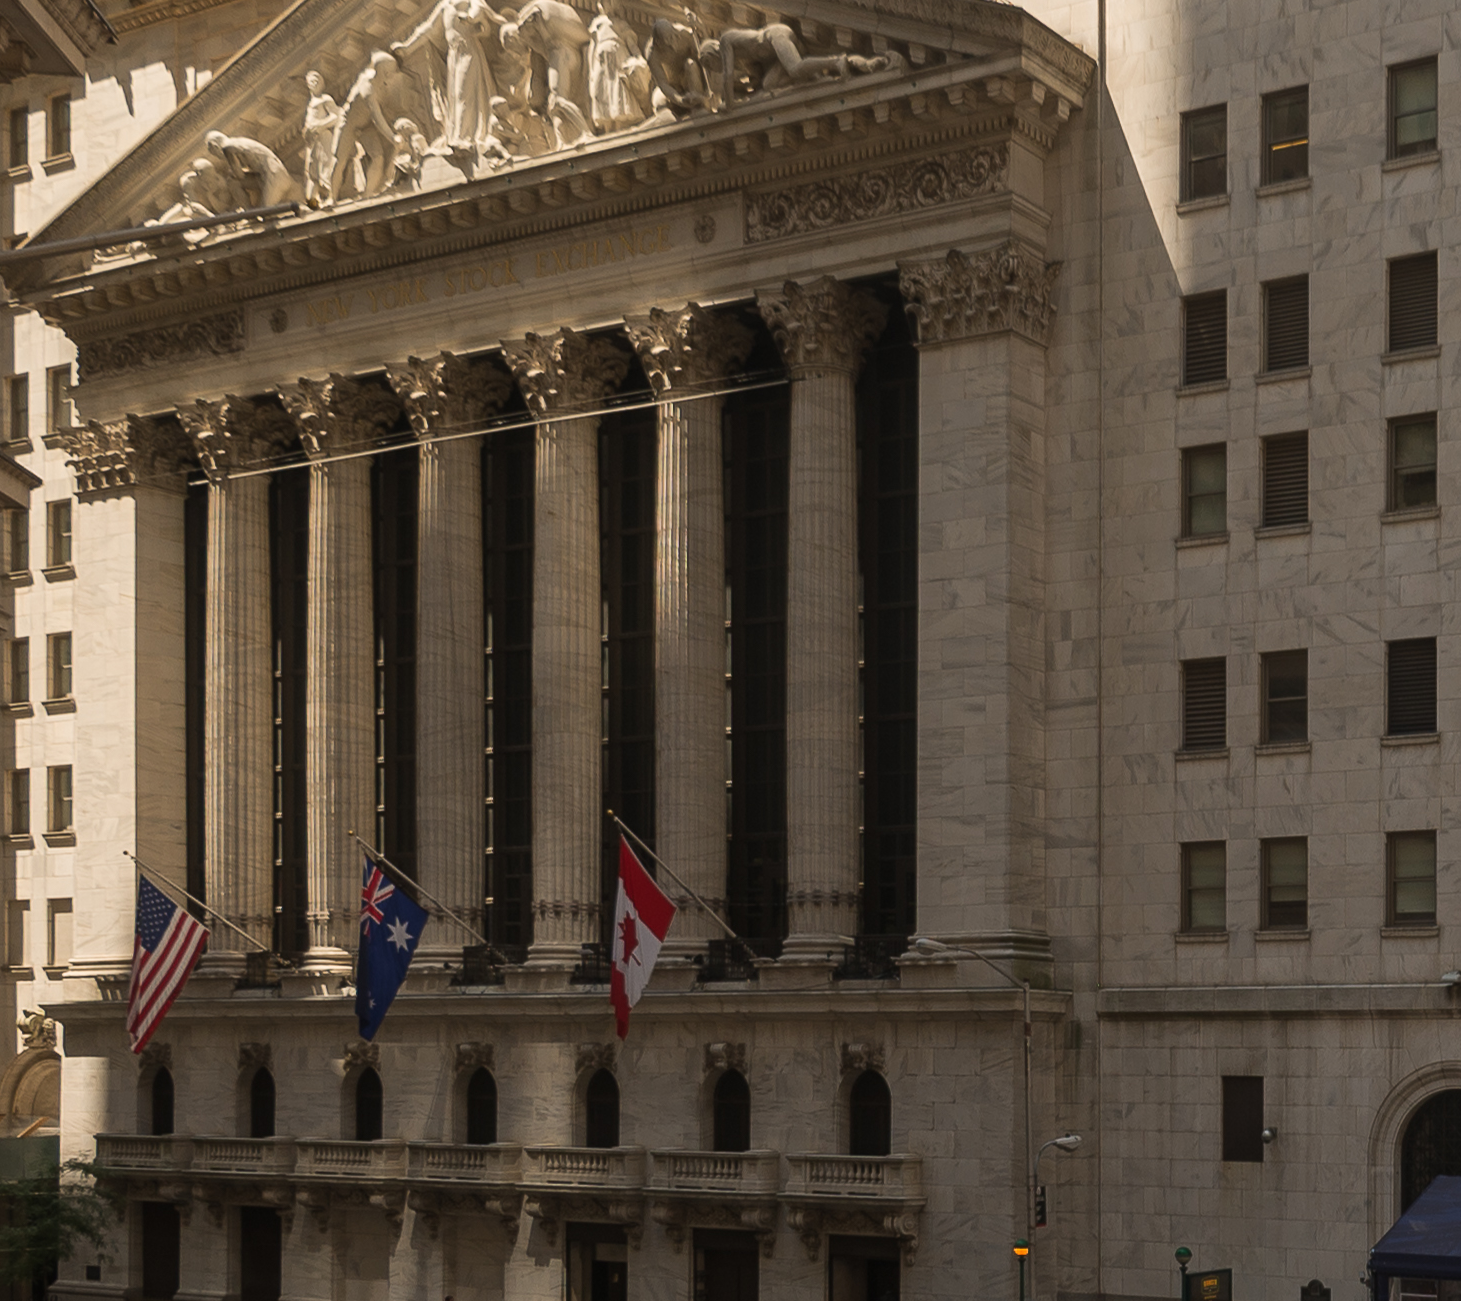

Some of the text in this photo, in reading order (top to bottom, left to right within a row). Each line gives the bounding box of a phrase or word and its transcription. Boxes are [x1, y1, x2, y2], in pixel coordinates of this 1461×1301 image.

[305, 224, 674, 327] NEW YORK STOCK EXCHANGE
